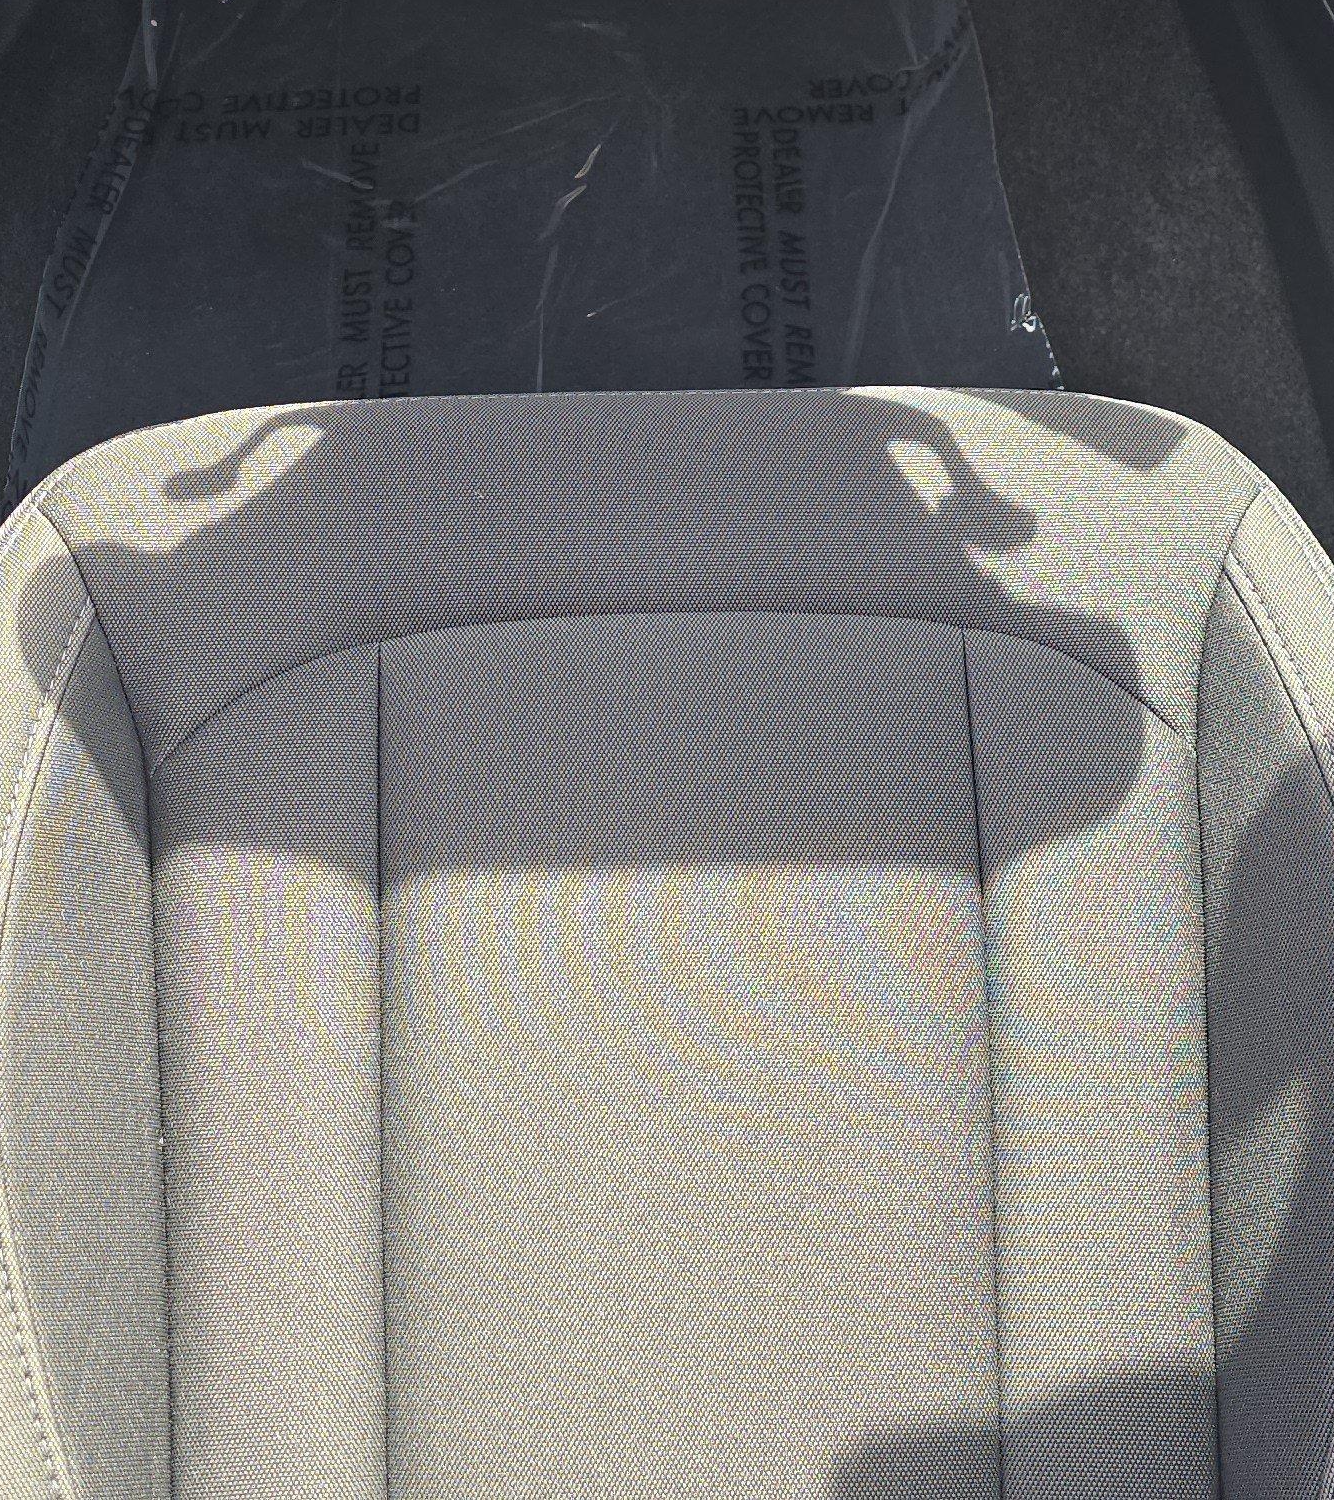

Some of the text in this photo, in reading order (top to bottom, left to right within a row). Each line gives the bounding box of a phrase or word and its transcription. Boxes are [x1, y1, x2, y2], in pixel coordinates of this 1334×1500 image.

[173, 116, 273, 145] MUST
[221, 83, 422, 116] PROTECTIVE
[296, 111, 421, 141] DEALER
[732, 102, 875, 127] REMOVE
[345, 141, 380, 251] REMOVE
[771, 127, 804, 216] DEALER
[44, 225, 98, 320] MUST
[732, 130, 774, 381] PROTECTIVE COVER
[777, 229, 812, 312] MUST
[338, 268, 373, 344] MUST
